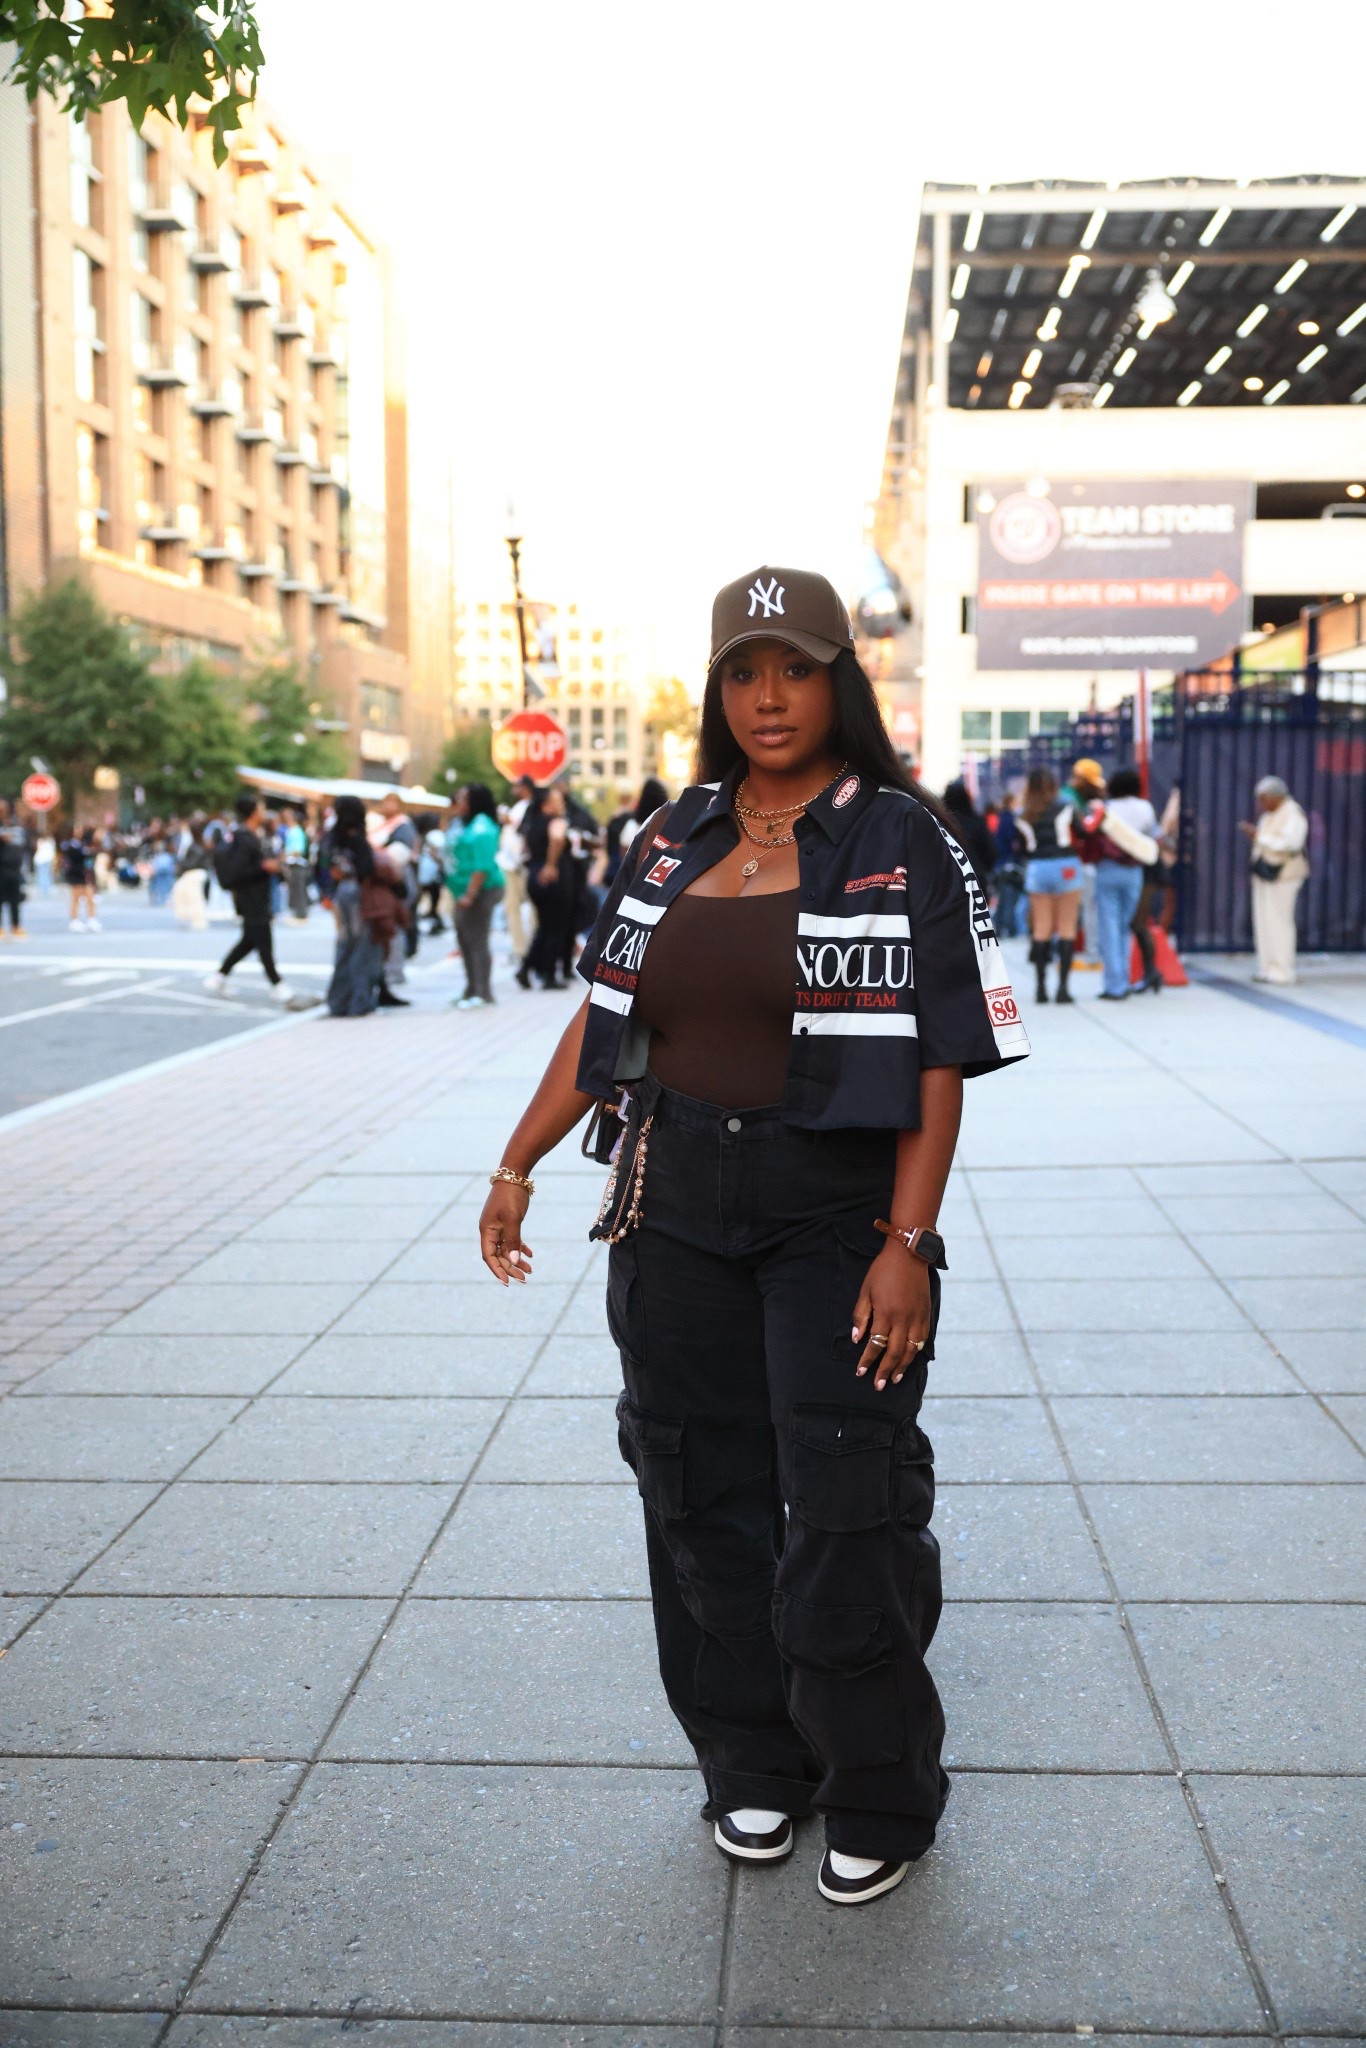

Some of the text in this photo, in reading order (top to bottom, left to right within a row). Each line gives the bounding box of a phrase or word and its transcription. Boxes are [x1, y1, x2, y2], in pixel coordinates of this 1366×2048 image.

[1062, 505, 1235, 534] TEAM STORE
[748, 577, 785, 617] NY
[985, 582, 1228, 603] INSIDE GATE ON THE LEFT
[495, 731, 562, 763] STOP
[845, 873, 904, 890] STRAIGHT
[813, 992, 852, 1007] DRIFT
[854, 993, 897, 1007] TEAM
[987, 988, 1013, 1000] STRAIGHT
[992, 998, 1017, 1021] 89
